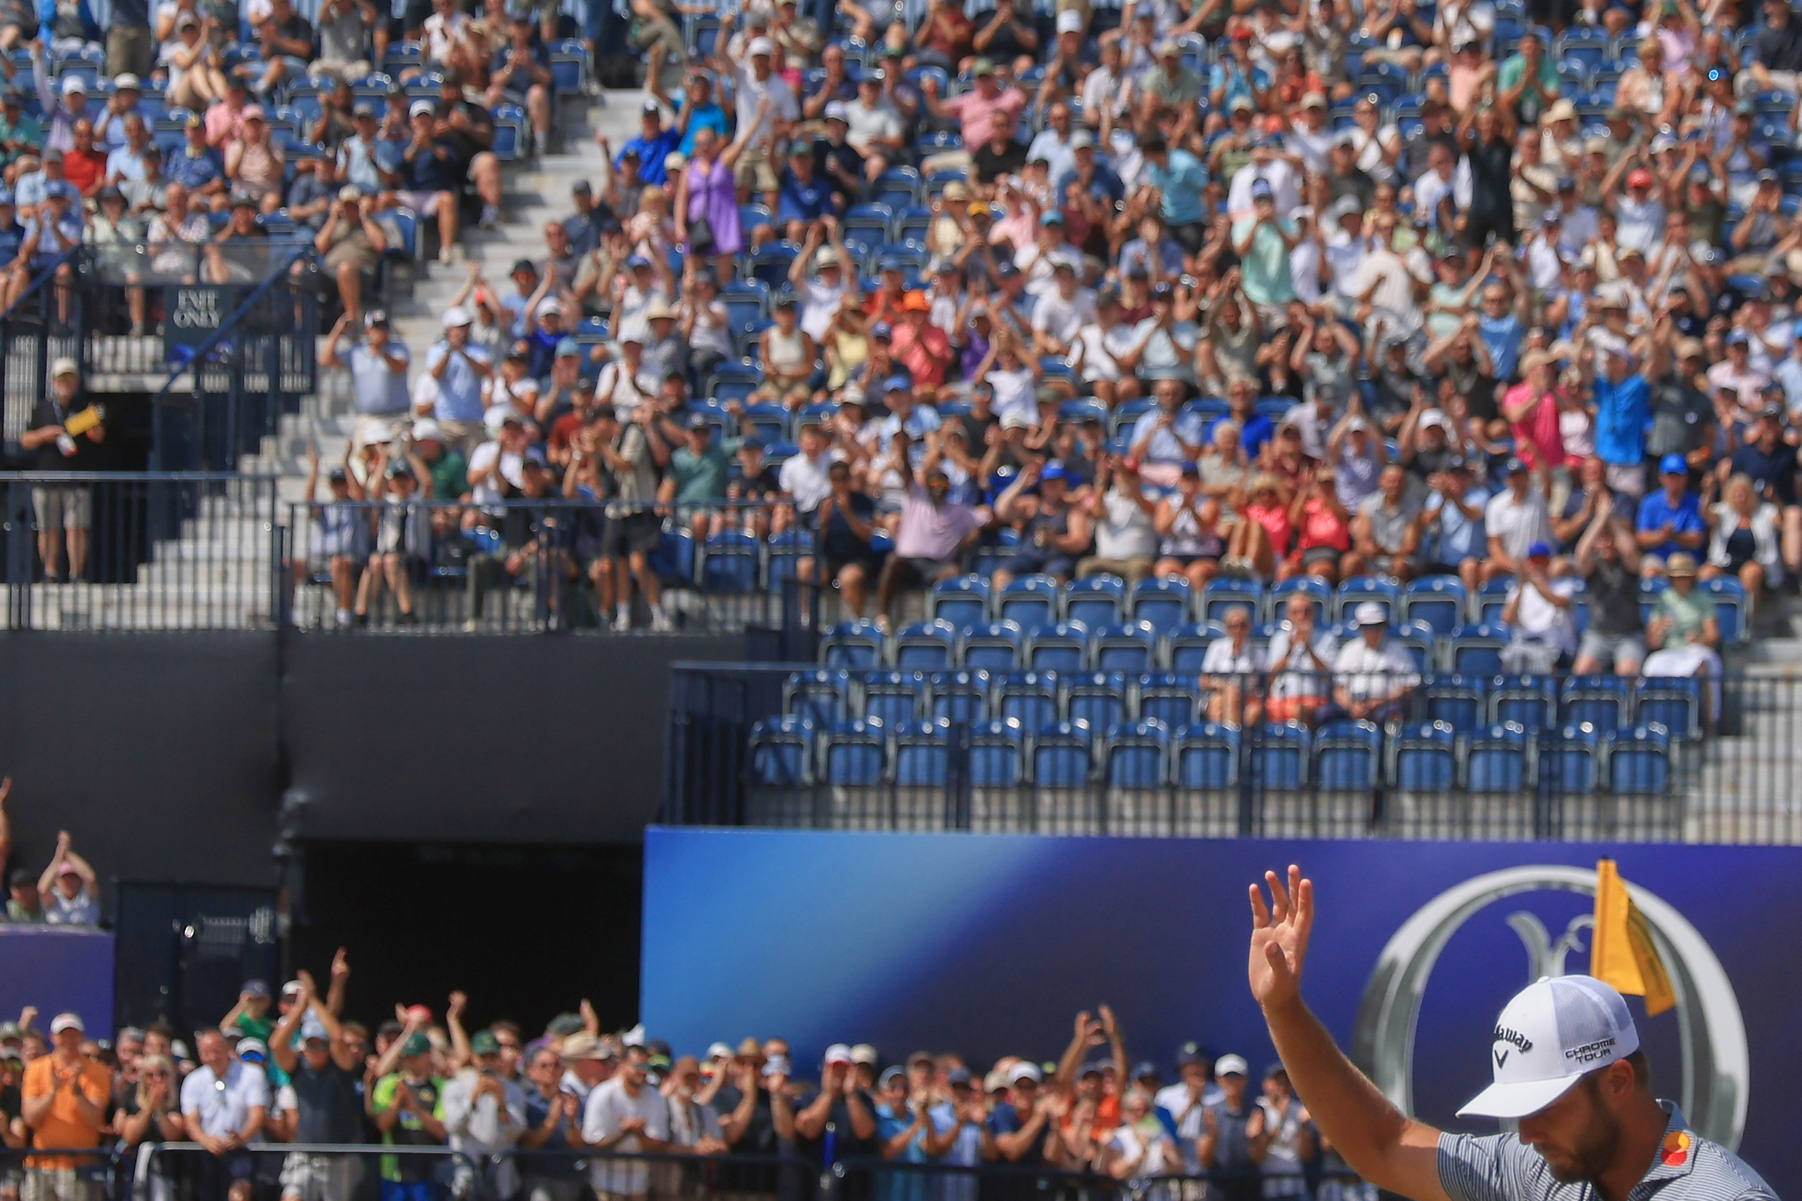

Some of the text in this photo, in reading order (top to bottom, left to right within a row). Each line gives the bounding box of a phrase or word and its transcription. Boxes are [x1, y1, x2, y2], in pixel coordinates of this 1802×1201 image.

[173, 308, 223, 328] ONLY
[1491, 1023, 1533, 1054] laway
[1565, 1037, 1616, 1059] CHROME
[1575, 1047, 1611, 1064] TOUR
